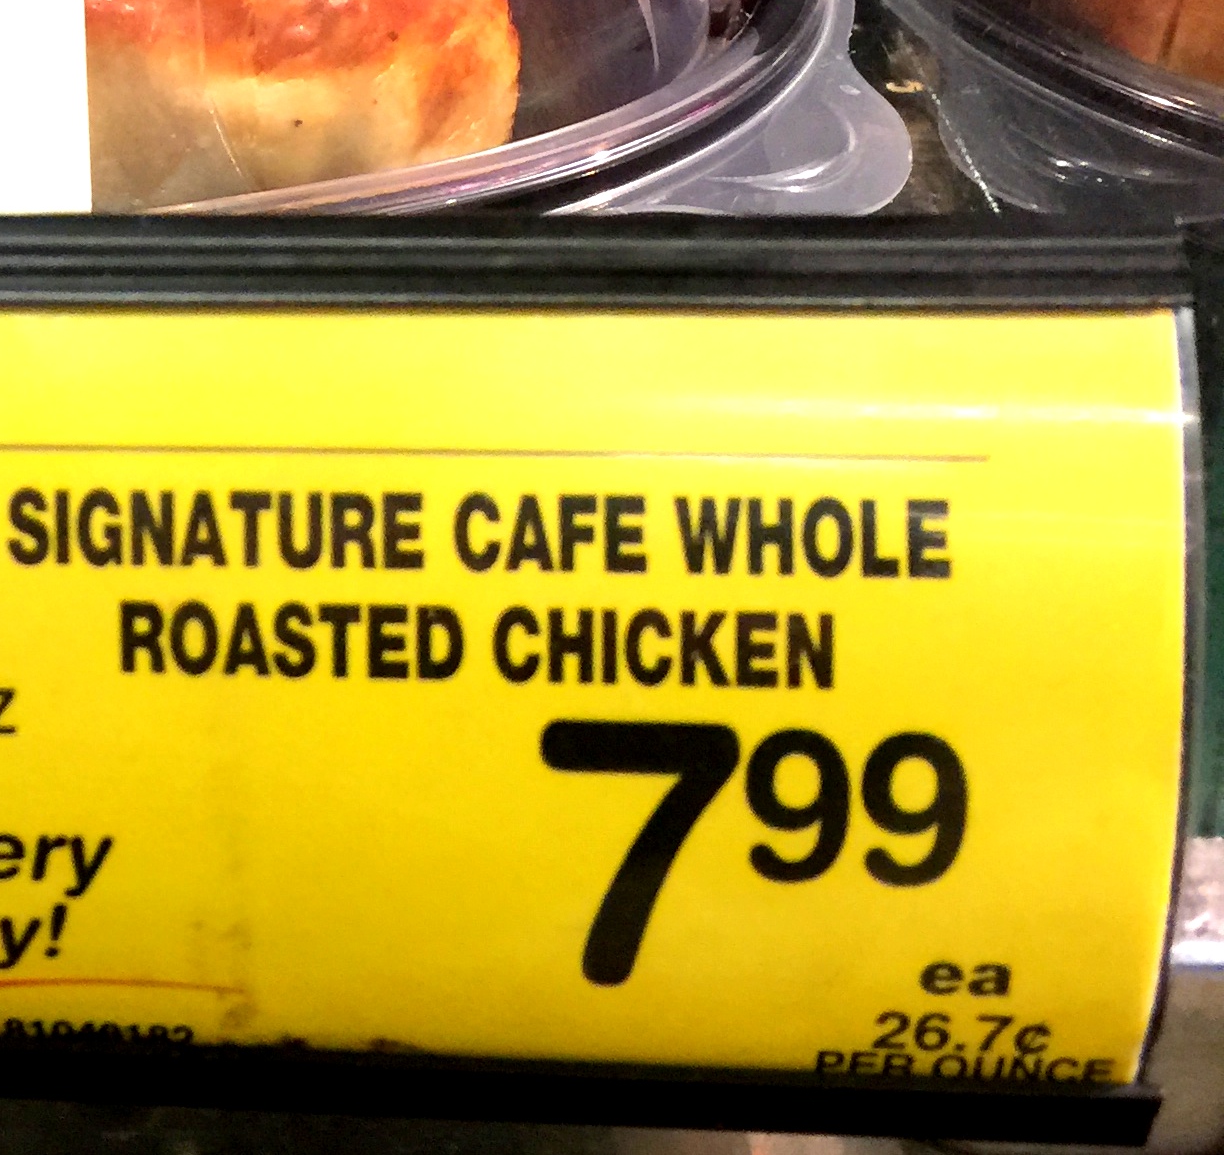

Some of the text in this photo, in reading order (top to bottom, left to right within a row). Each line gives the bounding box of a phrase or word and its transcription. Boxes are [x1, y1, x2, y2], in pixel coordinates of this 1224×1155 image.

[6, 487, 953, 580] SIGNATURE CAFE WHOLE
[118, 600, 836, 691] ROASTED CHICKEN
[918, 959, 1013, 998] ea
[815, 1049, 1118, 1085] PER OUNCE
